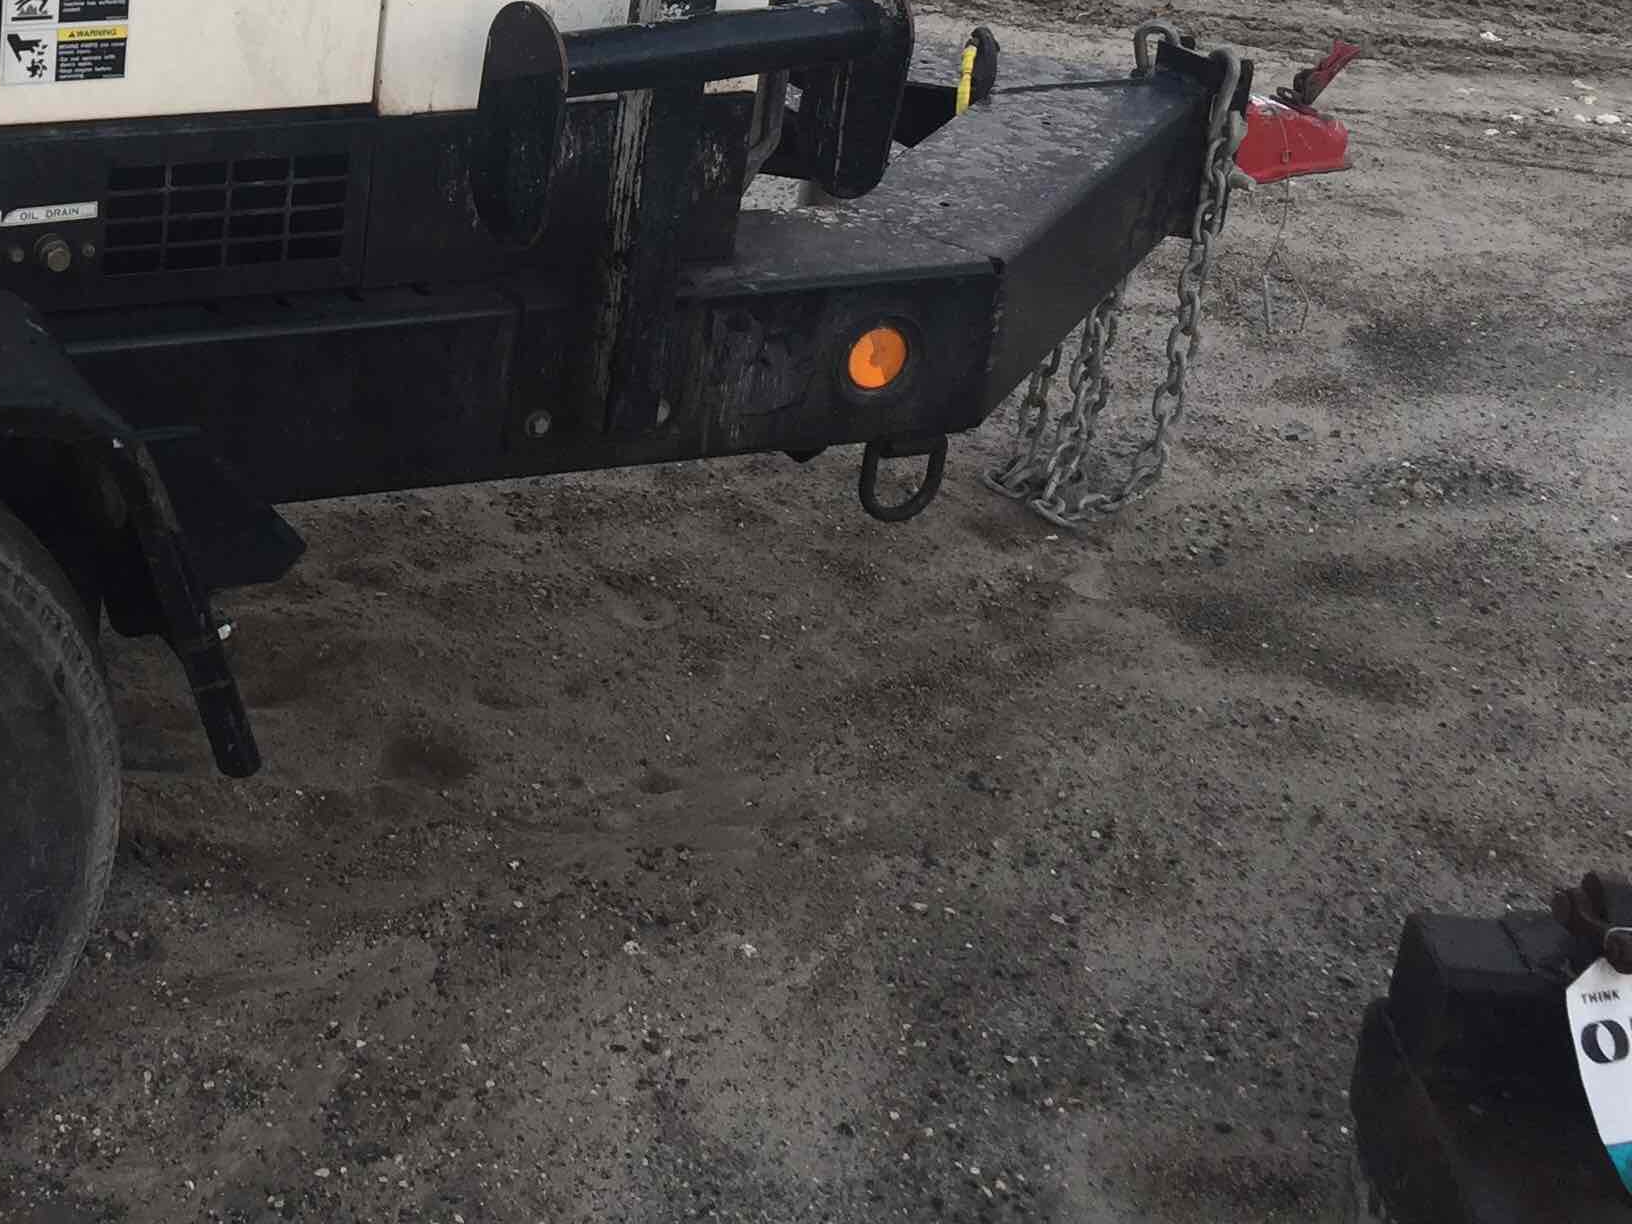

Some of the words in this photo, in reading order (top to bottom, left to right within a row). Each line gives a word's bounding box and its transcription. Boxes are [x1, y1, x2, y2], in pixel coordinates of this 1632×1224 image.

[76, 30, 117, 39] WARNING
[20, 210, 38, 221] OIL
[46, 206, 80, 218] DRAIN
[1582, 990, 1620, 1004] THINK
